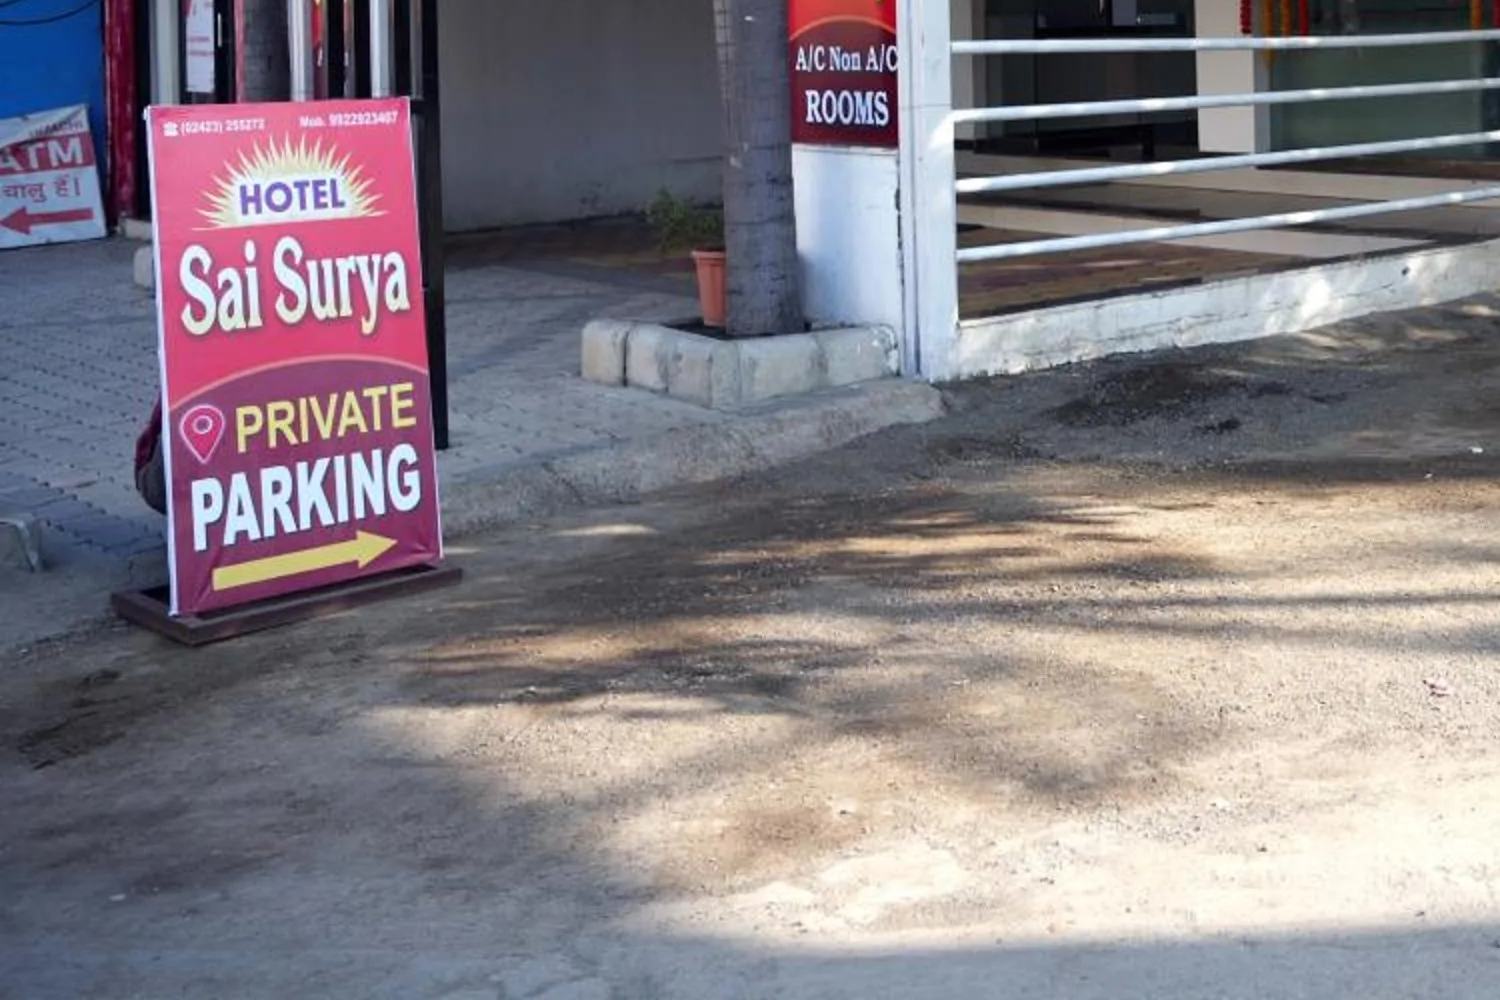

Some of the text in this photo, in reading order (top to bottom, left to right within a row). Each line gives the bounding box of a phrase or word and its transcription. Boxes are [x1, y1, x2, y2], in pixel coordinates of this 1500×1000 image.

[795, 45, 898, 72] A/C Non A/C
[805, 89, 889, 127] ROOMS
[239, 178, 346, 216] HOTEL
[179, 236, 410, 336] Sai Surya
[236, 382, 417, 453] PRIVATE
[191, 443, 422, 552] PARKING
